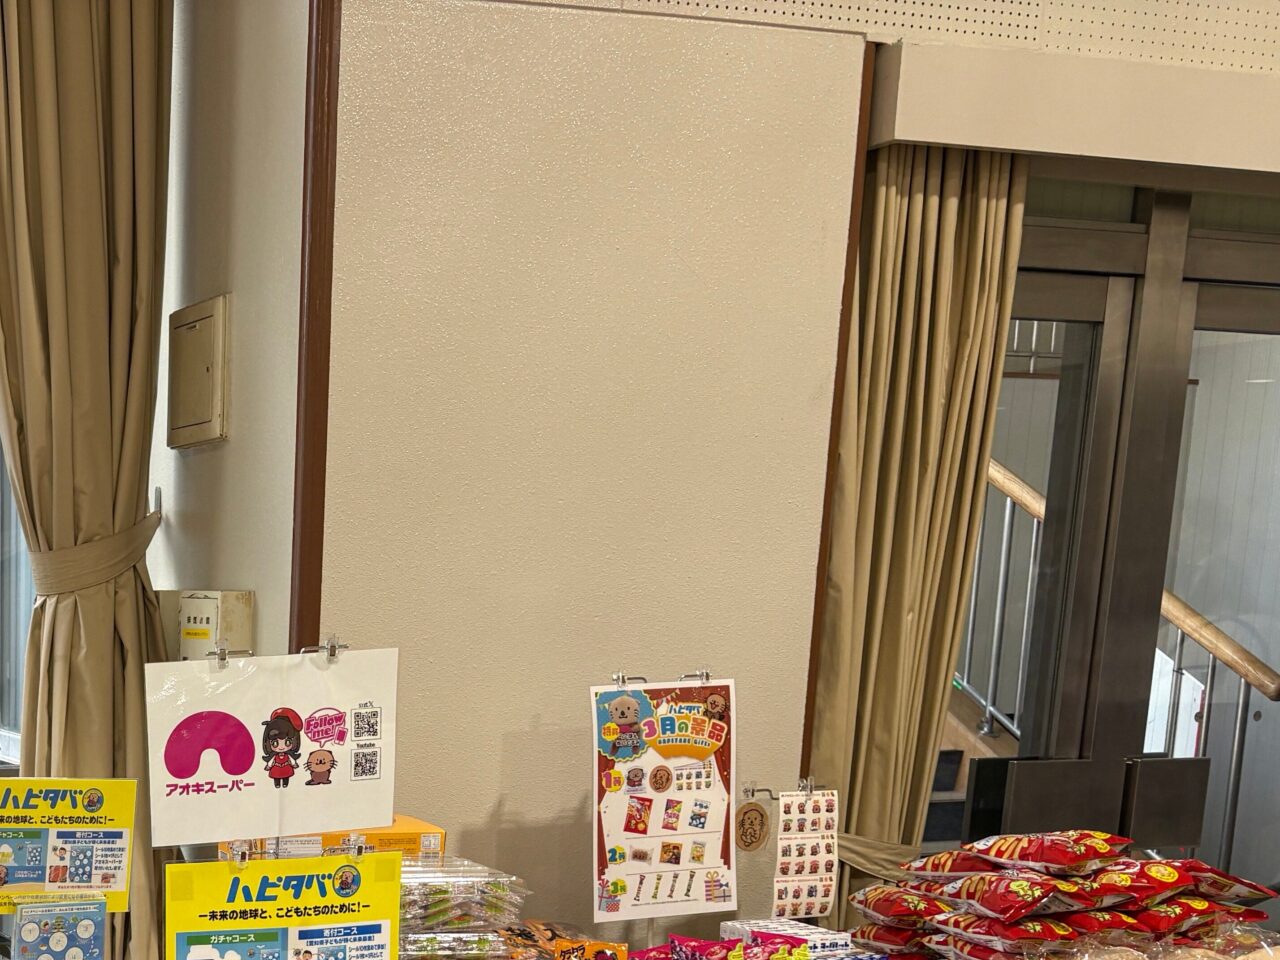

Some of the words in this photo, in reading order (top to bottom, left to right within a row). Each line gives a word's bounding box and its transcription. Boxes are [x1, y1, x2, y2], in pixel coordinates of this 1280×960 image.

[304, 712, 346, 731] Follow
[311, 726, 335, 739] me!
[642, 716, 725, 743] 3月の景品
[165, 780, 255, 797] アオキスーパー
[210, 934, 255, 943] ガチャコース
[323, 927, 358, 936] 寄付コース
